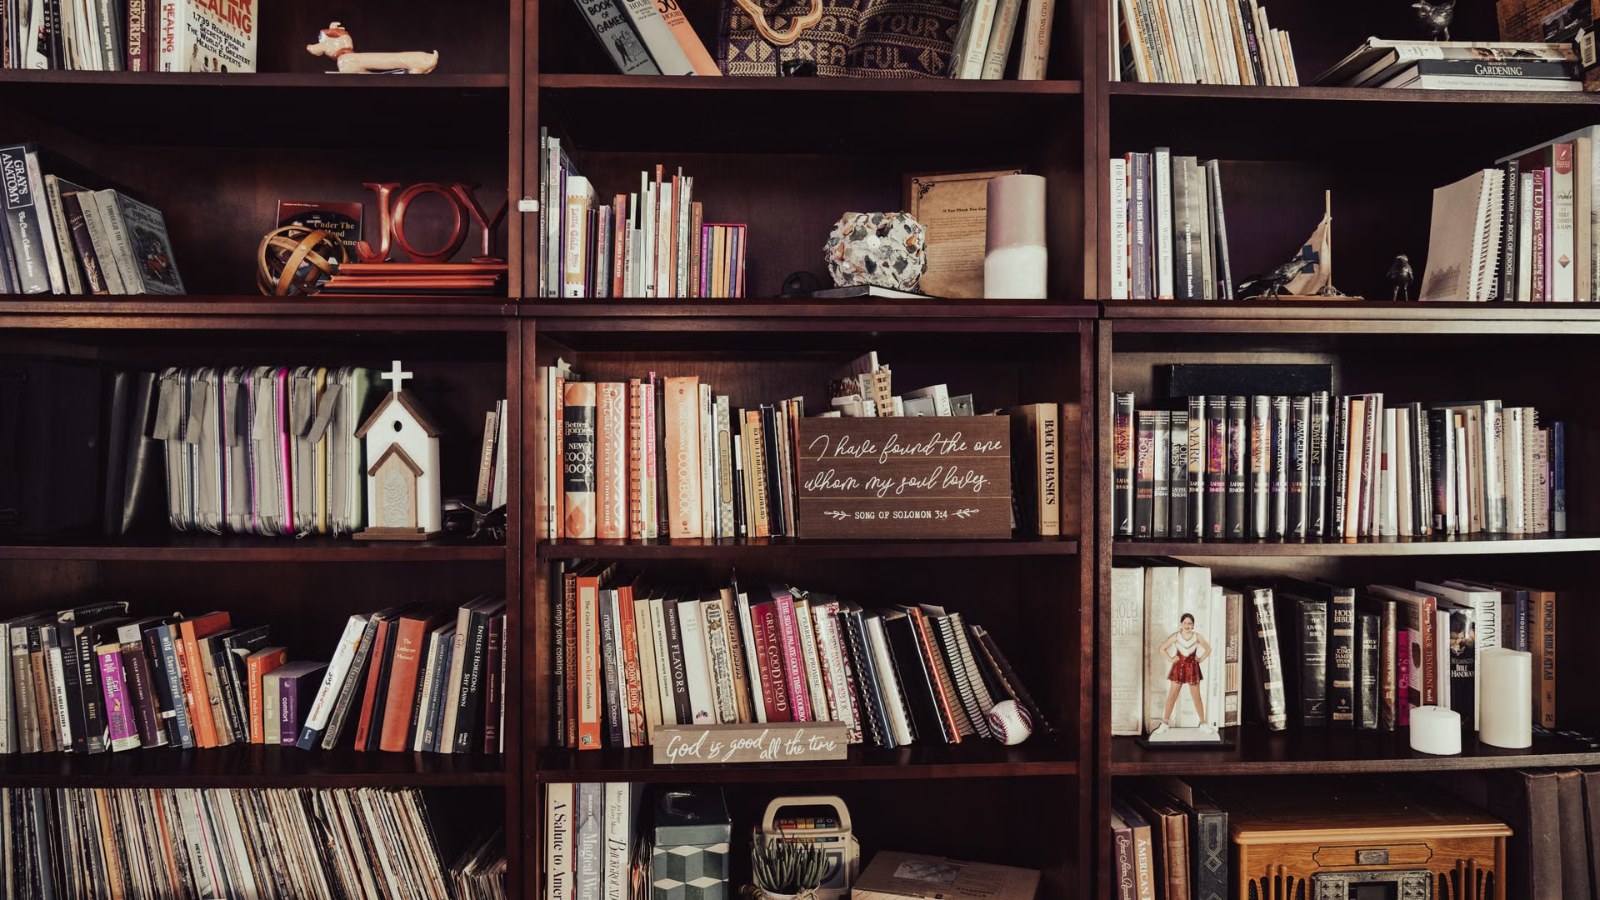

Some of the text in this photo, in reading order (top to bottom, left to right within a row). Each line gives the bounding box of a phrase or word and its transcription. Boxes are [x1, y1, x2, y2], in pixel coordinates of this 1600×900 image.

[588, 0, 613, 15] BOOK
[601, 11, 611, 19] OF
[628, 0, 652, 10] HOURS
[663, 11, 683, 20] HOURS
[130, 0, 141, 55] SECRETS
[166, 3, 175, 53] HEALING
[193, 12, 246, 49] 1,739 REMARKABLE
[199, 24, 240, 52] SECRETS FROM
[596, 14, 626, 33] GAMES
[1038, 2, 1048, 45] OLD WORLD
[187, 23, 251, 65] THE WORLD'S GREATEST
[196, 38, 242, 68] HEALTH EXPERTS
[1474, 65, 1523, 76] GARDENING
[2, 153, 20, 204] ANATOMY
[13, 160, 28, 195] GRAY'S
[1115, 164, 1123, 177] THE
[1115, 178, 1123, 193] END
[1116, 194, 1123, 205] OF
[1508, 173, 1516, 212] COMPANION
[1534, 187, 1544, 231] T.D. Jakes
[341, 221, 355, 230] The
[356, 181, 508, 263] JOY
[1116, 221, 1124, 243] ROAD
[1136, 221, 1144, 246] HISTORY
[1507, 224, 1515, 241] BOOK
[1506, 252, 1514, 276] ENOCH
[1507, 242, 1514, 251] OF
[809, 431, 1002, 463] I have found the one
[1044, 420, 1055, 505] BACK TO BASICS
[1190, 426, 1201, 465] MARK
[1296, 419, 1304, 471] ARMAGEDDON
[679, 451, 690, 517] COOKBOOK
[804, 468, 860, 492] whom
[865, 476, 895, 498] my
[894, 466, 942, 494] soul
[854, 509, 948, 520] SONG OF SOLOMON 3:4
[555, 603, 563, 675] simply slow cooking
[566, 577, 577, 691] ELEGANT DESSERTS
[604, 614, 614, 640] market
[625, 624, 633, 637] Betty
[1543, 600, 1554, 680] CONCISE BIBLE ATLAS
[80, 635, 93, 686] RICHARD WRIGHT
[470, 625, 484, 693] ENDLESS HORIZONS:
[604, 642, 616, 684] vegetarian
[669, 608, 684, 693] NORDSTROM FLAVORS
[755, 624, 772, 703] JULEE ROSSO
[765, 612, 787, 711] GREAT GOOD FOOD
[781, 601, 800, 694] THE SILVER PALATE GOOD TIMES
[801, 616, 820, 688] PERRICONE PROMISE
[166, 655, 181, 699] Cheryl Strayed
[182, 670, 190, 692] TRAVEL
[250, 662, 258, 688] Webster's
[627, 661, 637, 685] COOKY
[1425, 651, 1433, 689] TESTAMENT
[460, 673, 471, 707] SHY DAWN
[630, 687, 639, 708] BOOK
[666, 728, 836, 763] God is good all the time
[553, 800, 567, 865] A Salute to
[579, 833, 598, 875] Magical
[1137, 838, 1150, 894] AMERICAN
